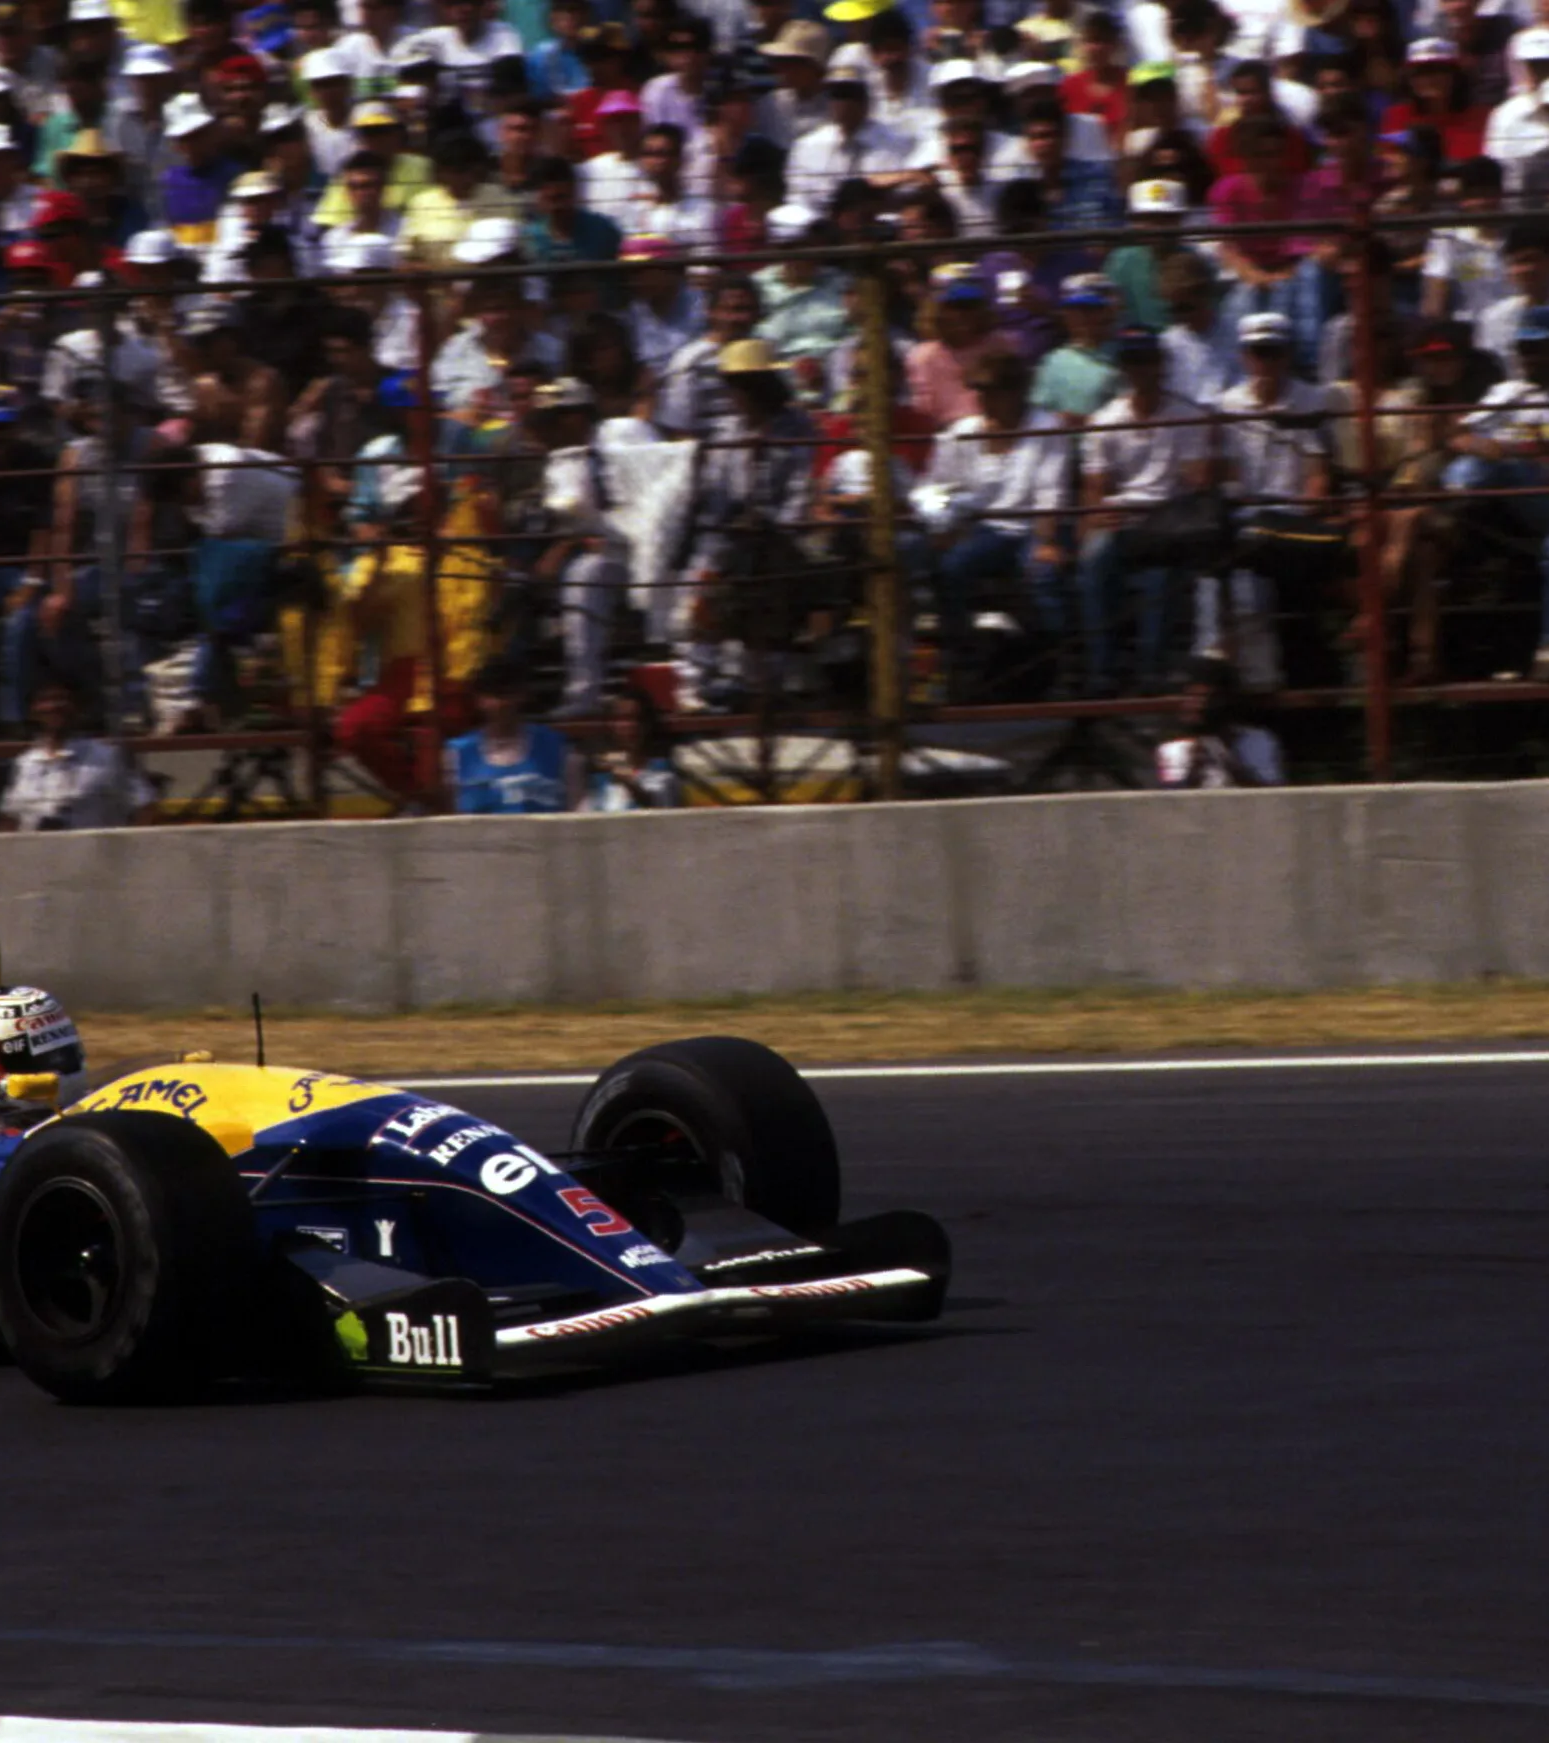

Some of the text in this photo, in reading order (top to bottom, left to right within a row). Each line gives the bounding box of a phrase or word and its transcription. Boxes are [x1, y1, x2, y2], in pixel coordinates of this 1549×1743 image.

[2, 1038, 27, 1053] elf
[556, 1187, 633, 1236] 5
[385, 1312, 462, 1367] Bull
[524, 1305, 654, 1340] Canon
